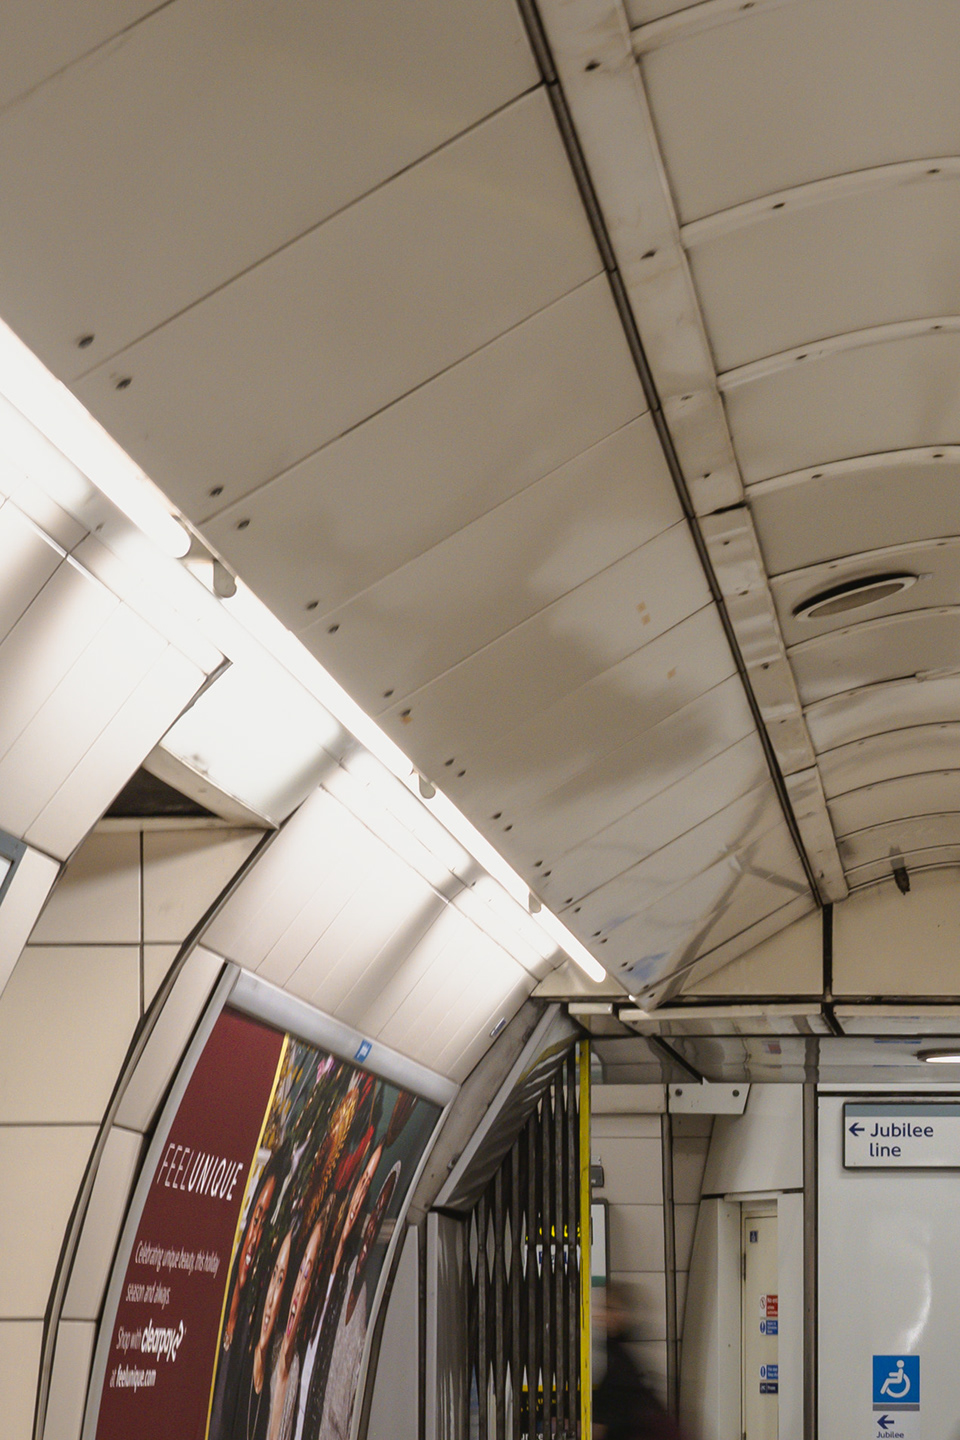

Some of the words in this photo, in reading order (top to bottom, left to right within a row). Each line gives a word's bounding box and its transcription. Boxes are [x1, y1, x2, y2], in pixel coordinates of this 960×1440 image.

[870, 1122, 934, 1139] Jubilee
[869, 1142, 902, 1158] line
[157, 1142, 244, 1201] FEELUNIQUE
[144, 1280, 156, 1304] and
[116, 1326, 132, 1355] Shop
[141, 1318, 178, 1362] clearpay
[116, 1363, 156, 1393] feelunique.com
[876, 1431, 904, 1439] Jubilee
